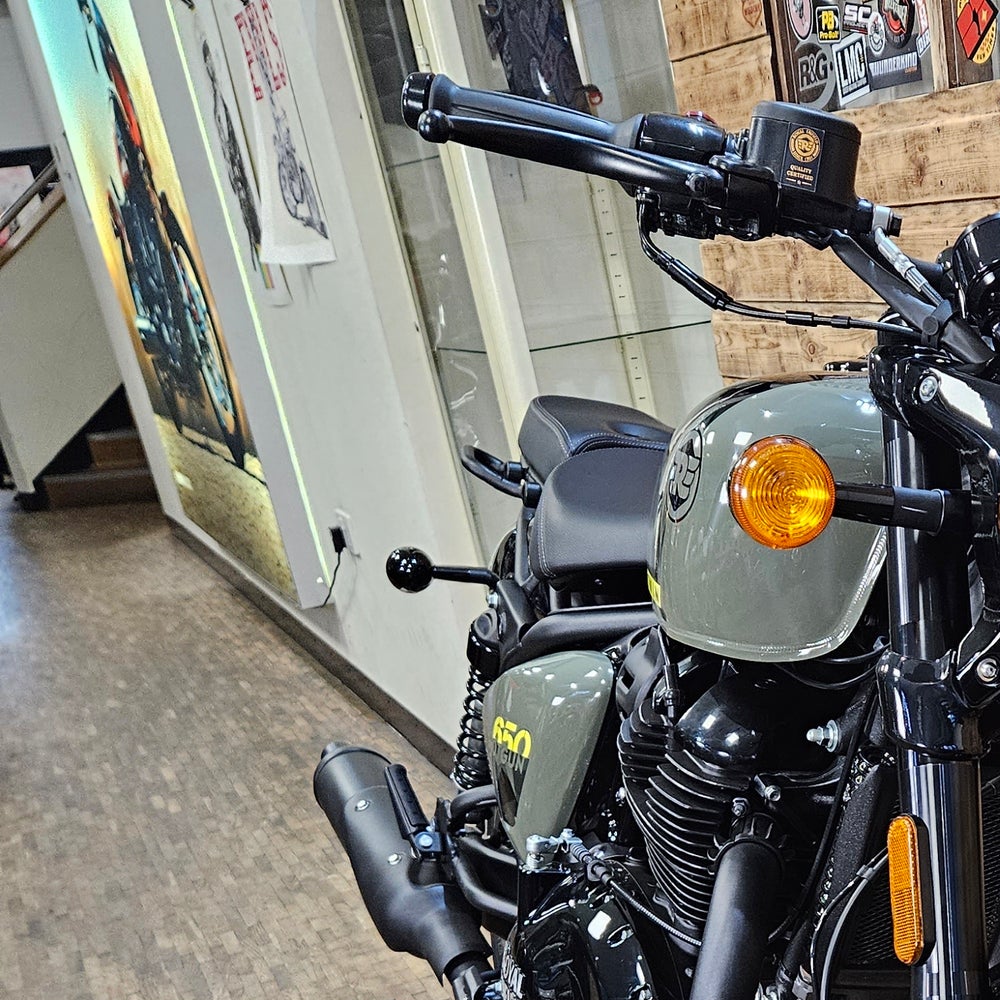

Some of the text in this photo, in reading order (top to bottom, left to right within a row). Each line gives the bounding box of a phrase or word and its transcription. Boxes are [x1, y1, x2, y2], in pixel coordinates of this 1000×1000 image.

[821, 10, 835, 31] PB
[844, 4, 872, 24] SC
[799, 51, 829, 89] R&G
[837, 41, 866, 88] LMC
[786, 170, 814, 181] CERTIFIED
[790, 164, 813, 174] QUALITY
